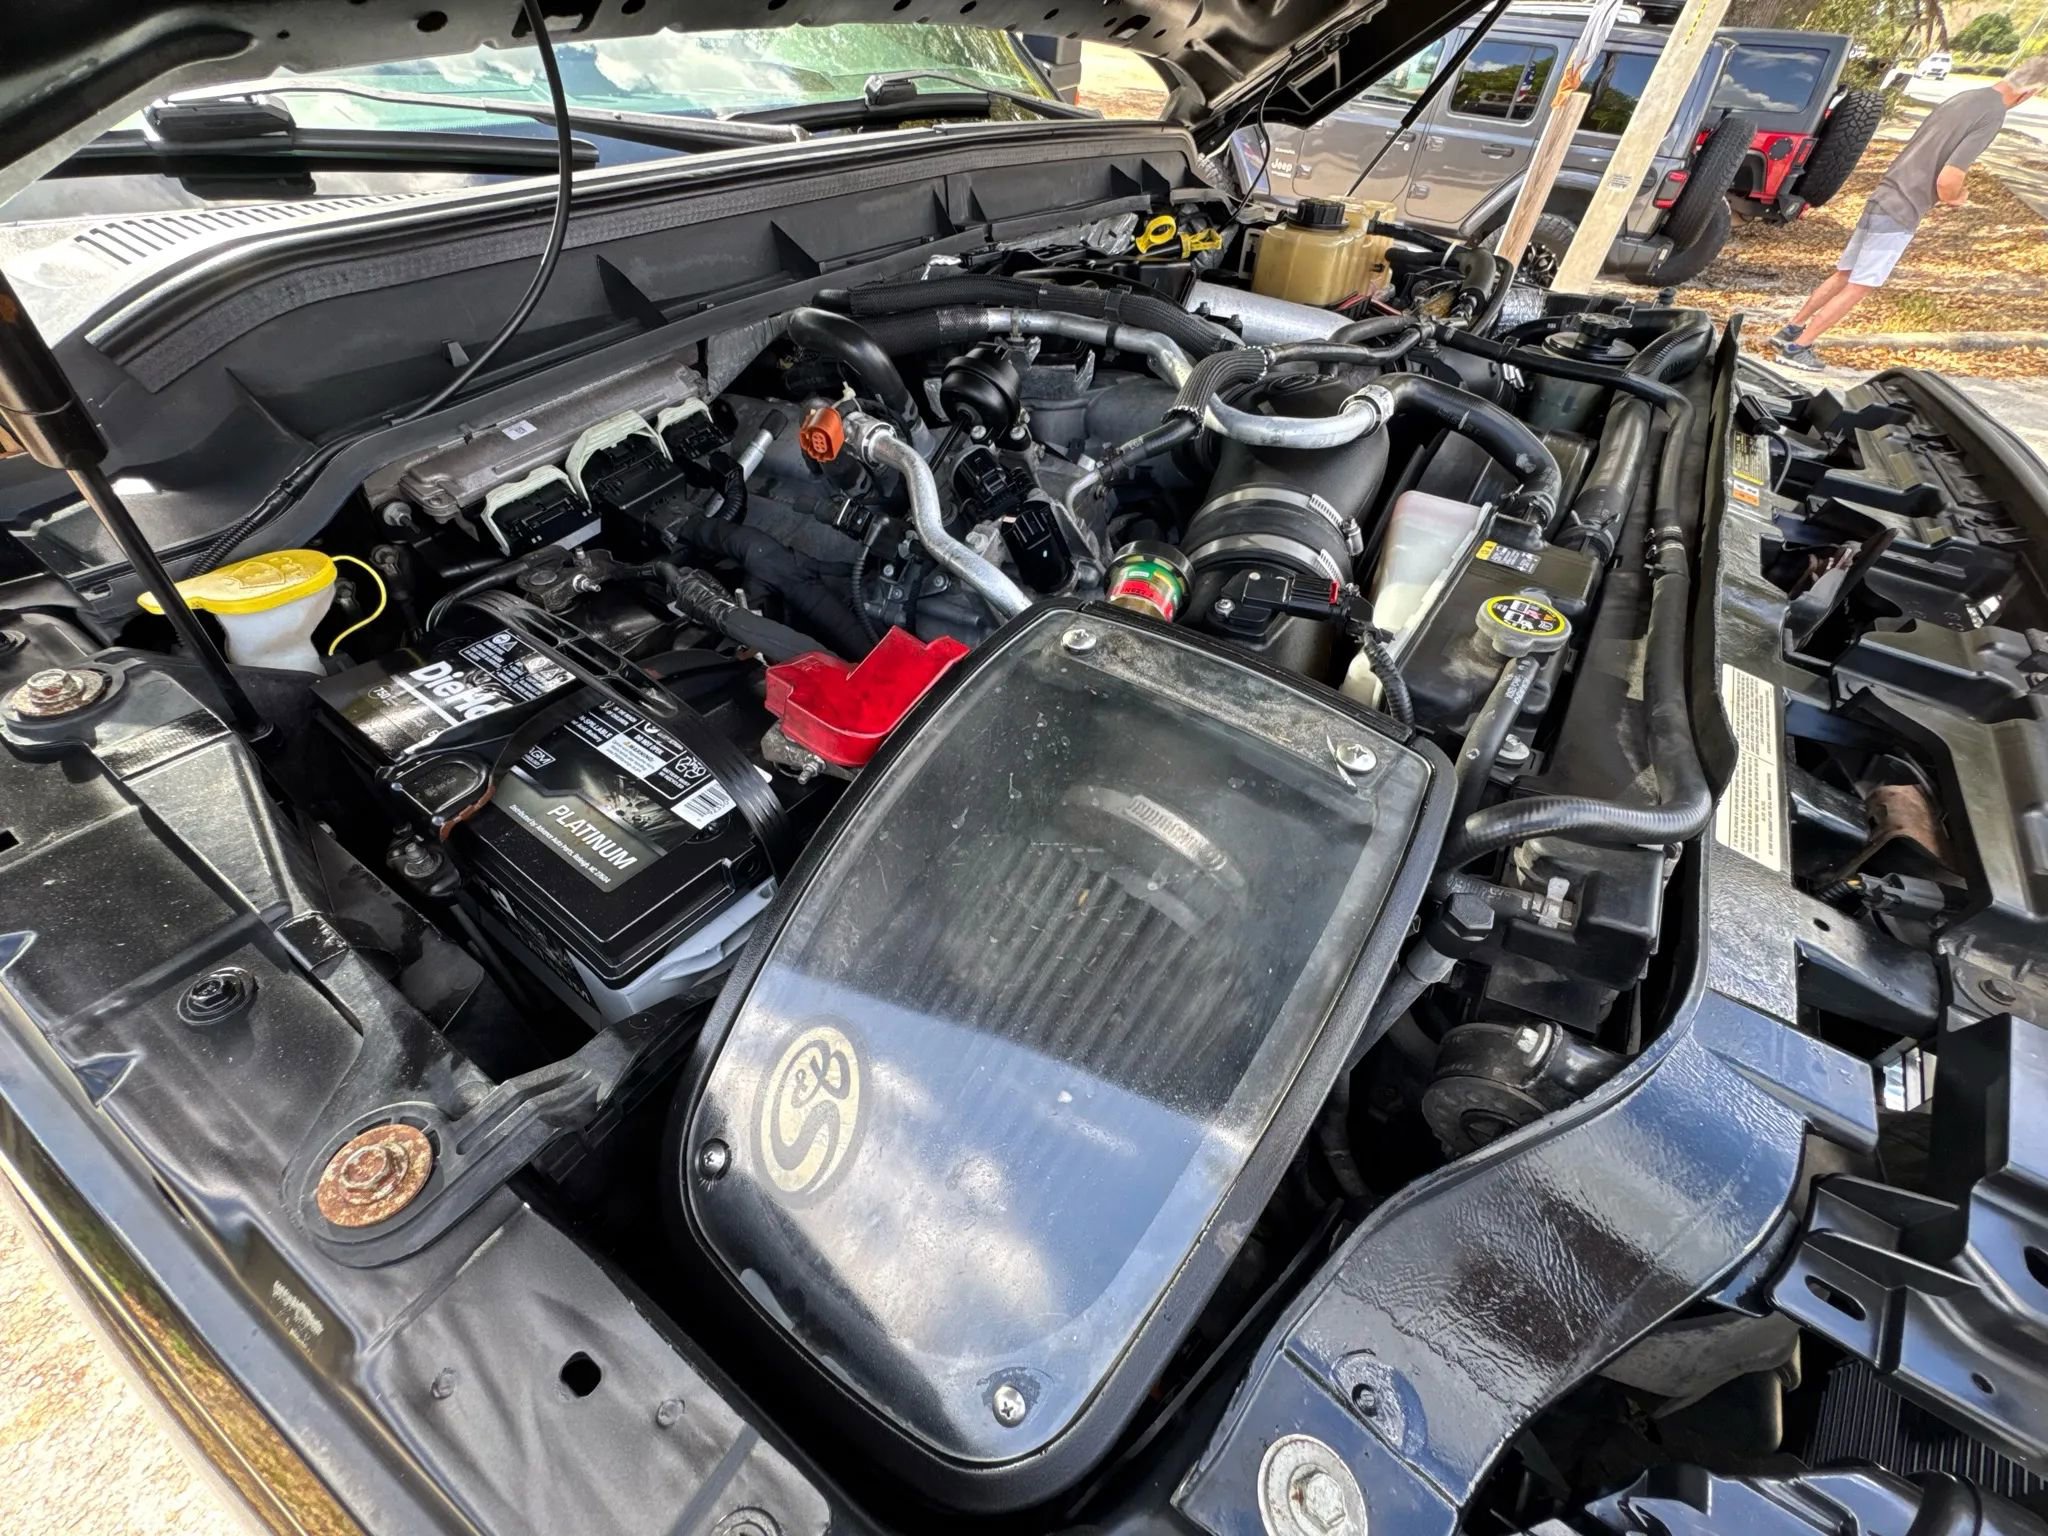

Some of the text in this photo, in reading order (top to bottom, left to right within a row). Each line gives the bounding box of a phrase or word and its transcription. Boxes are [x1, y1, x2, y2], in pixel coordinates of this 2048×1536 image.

[1271, 158, 1293, 172] Jeep
[508, 803, 533, 822] Distributed
[535, 824, 554, 838] Advance
[550, 836, 564, 846] Auto
[545, 803, 638, 870] PLATINUM
